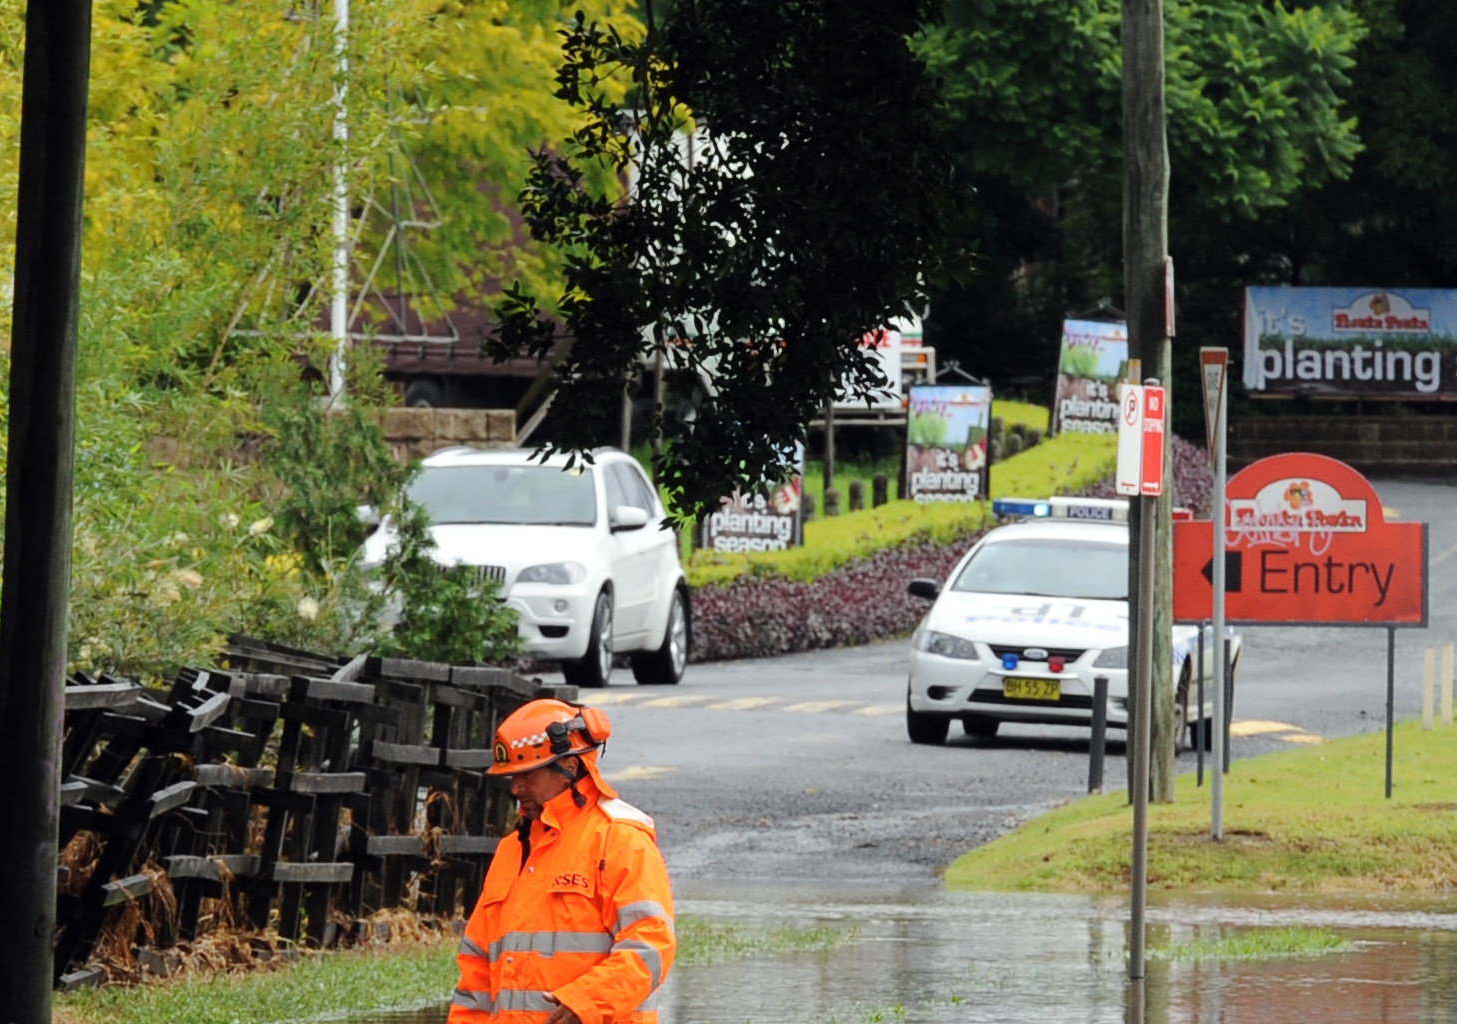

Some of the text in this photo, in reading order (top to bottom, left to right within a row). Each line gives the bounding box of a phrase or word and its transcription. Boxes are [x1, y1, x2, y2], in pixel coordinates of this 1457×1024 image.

[1255, 339, 1441, 392] planting
[1060, 395, 1121, 420] plantin
[1149, 396, 1159, 412] NO
[911, 466, 980, 497] planting
[710, 508, 792, 541] planting
[1070, 506, 1110, 519] POLICE
[713, 535, 788, 554] season
[1261, 550, 1395, 607] Entry
